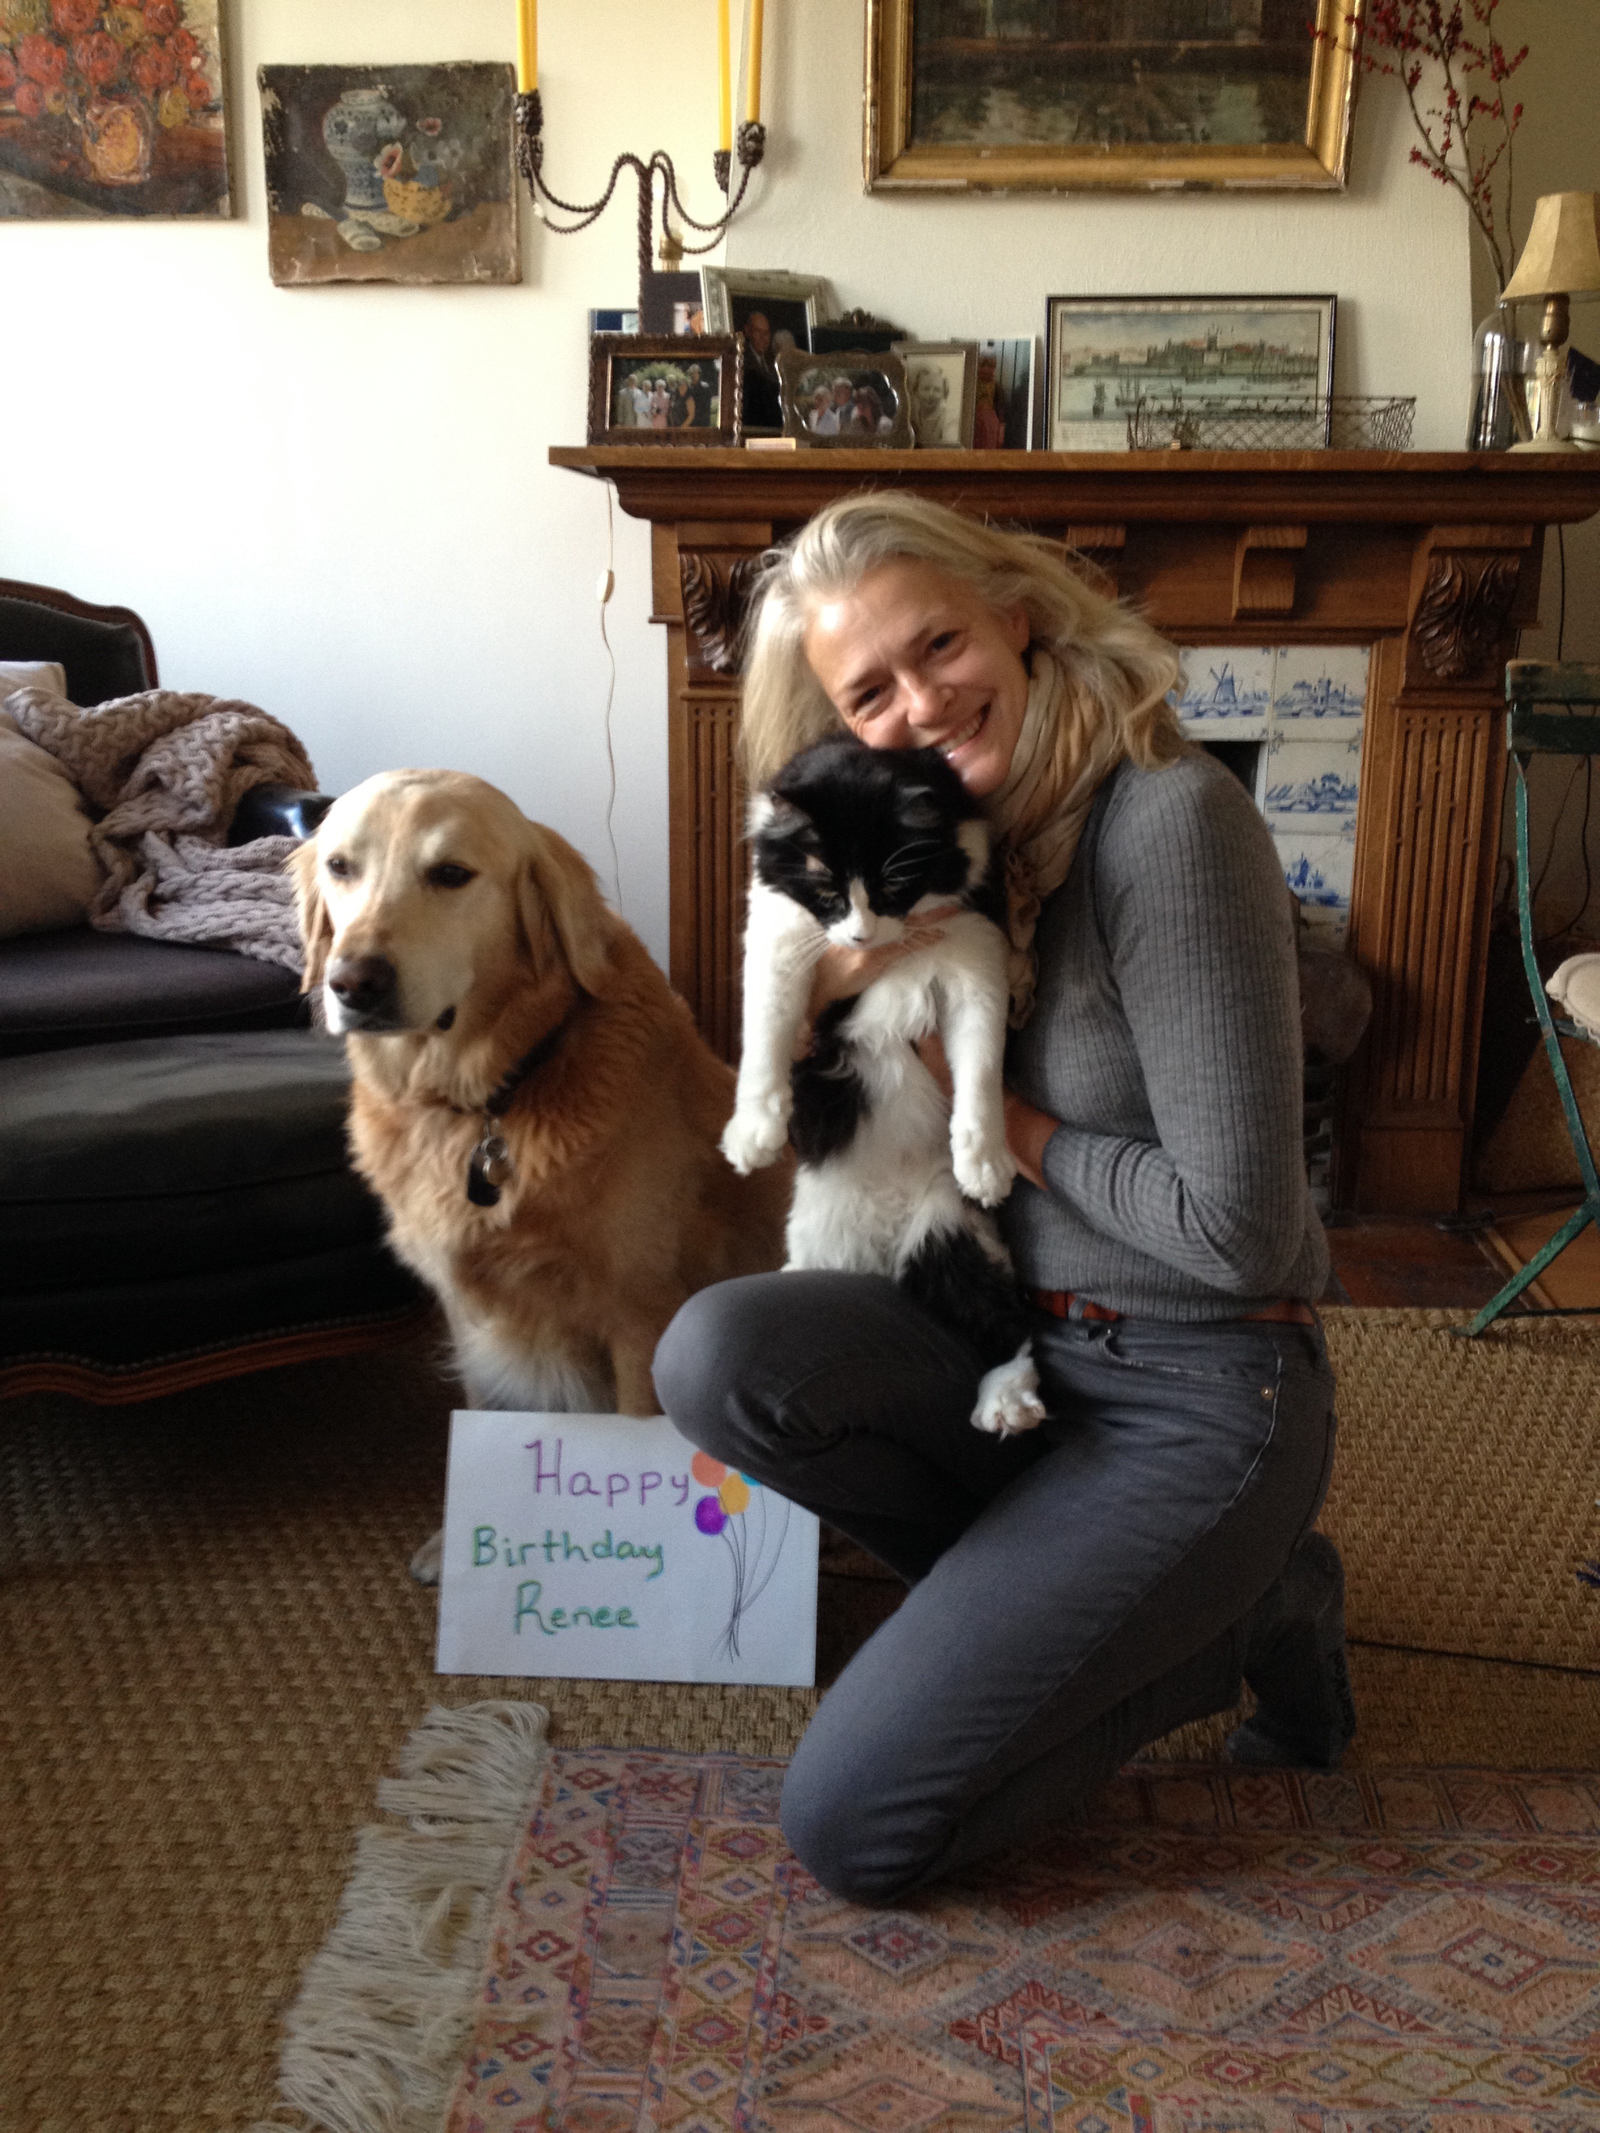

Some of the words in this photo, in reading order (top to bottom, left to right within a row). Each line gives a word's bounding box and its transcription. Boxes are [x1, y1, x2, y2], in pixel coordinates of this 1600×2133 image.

[524, 1438, 690, 1507] Happy
[472, 1524, 665, 1581] Birthday
[514, 1579, 638, 1635] Renee
